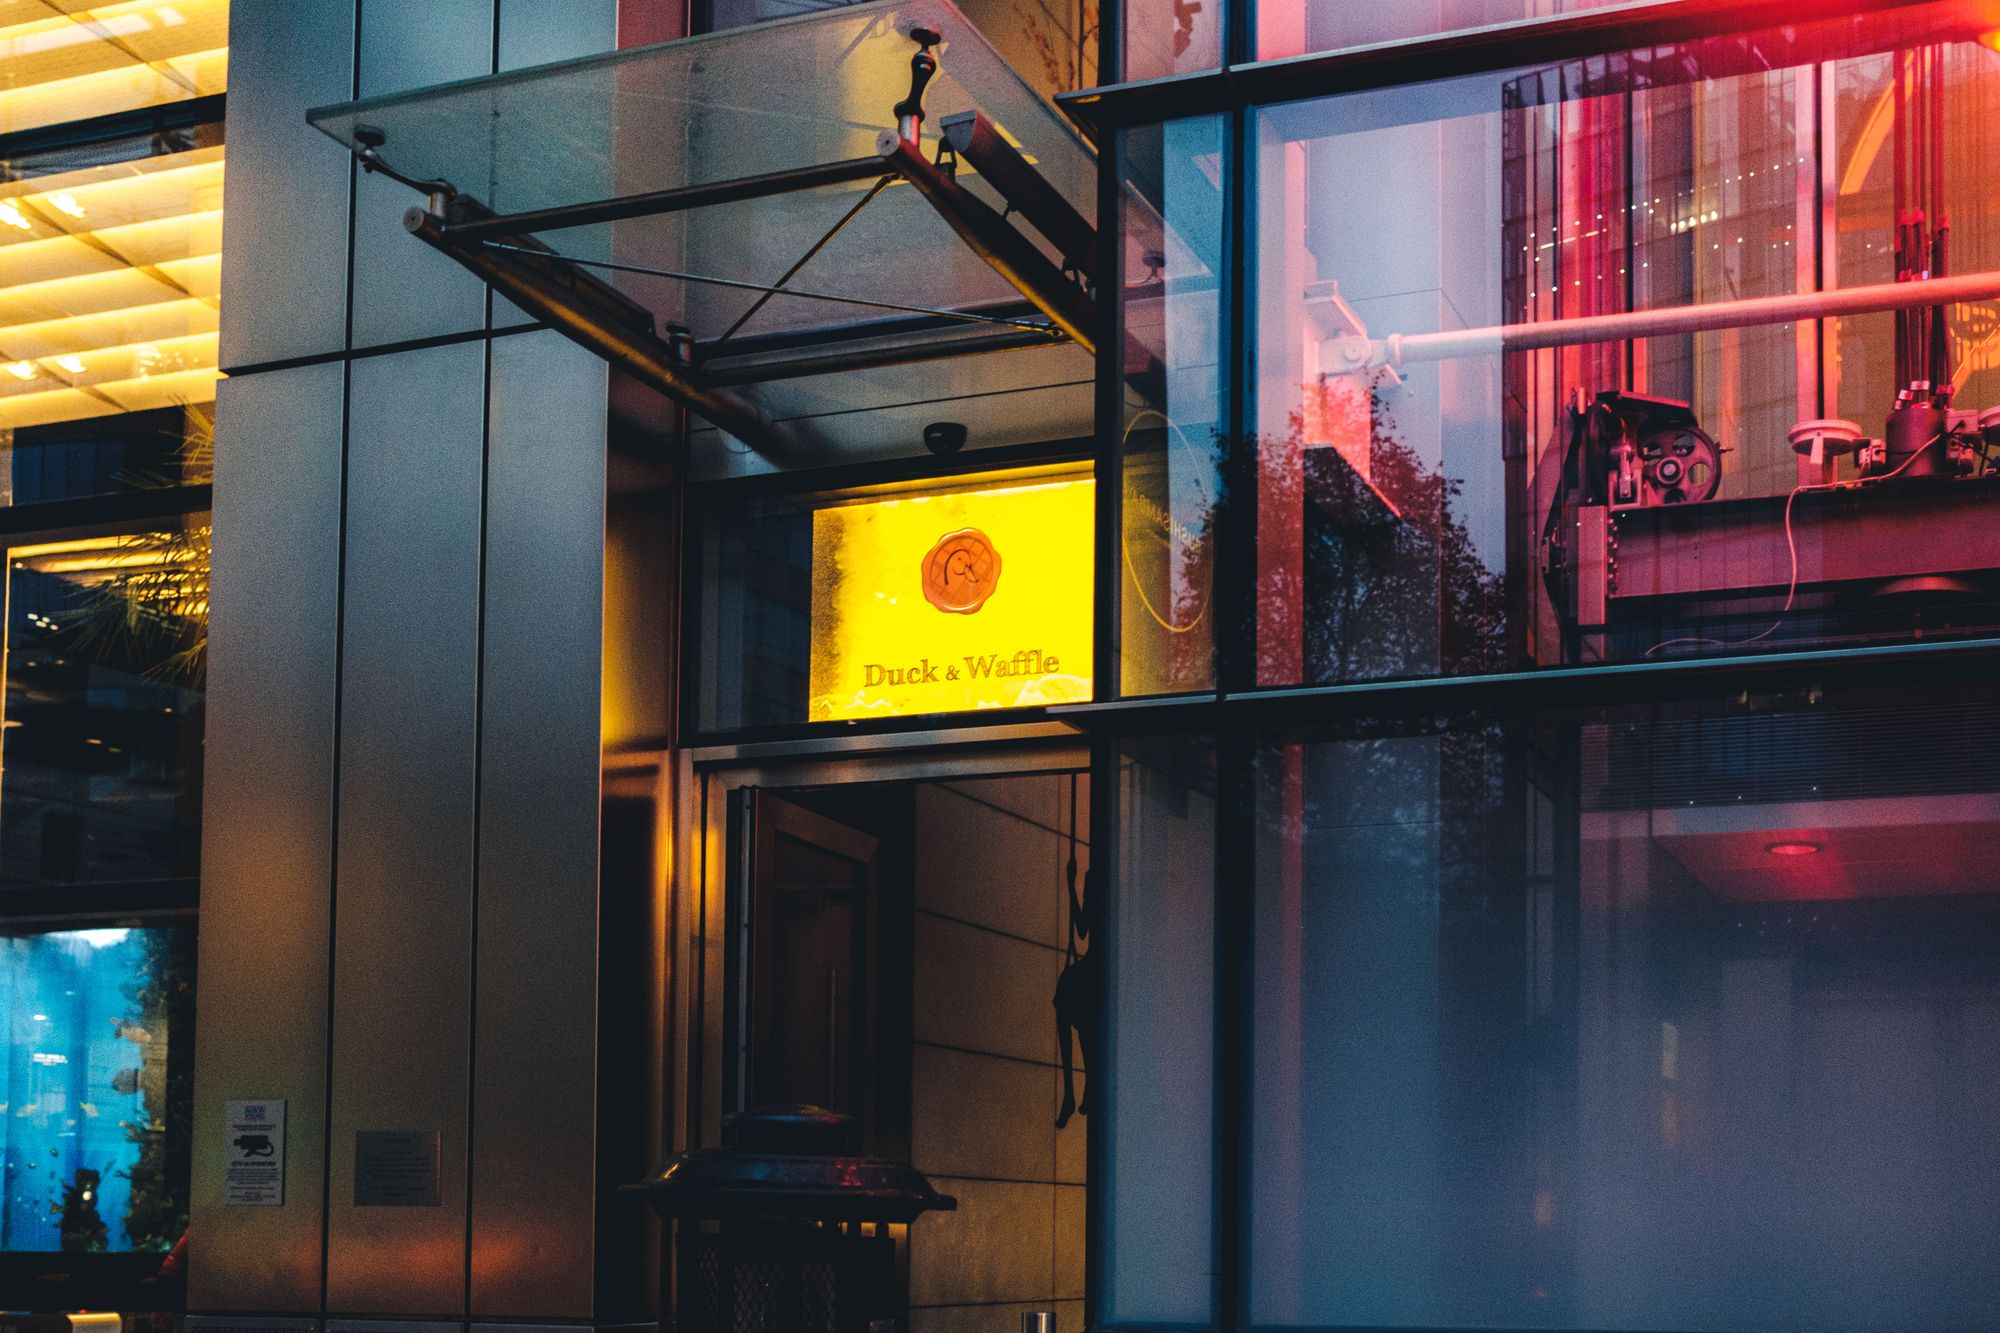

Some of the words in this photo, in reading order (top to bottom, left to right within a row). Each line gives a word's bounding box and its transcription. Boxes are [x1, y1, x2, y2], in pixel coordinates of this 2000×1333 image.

[864, 659, 939, 688] Duck
[945, 666, 960, 681] &
[963, 648, 1060, 680] Waffle
